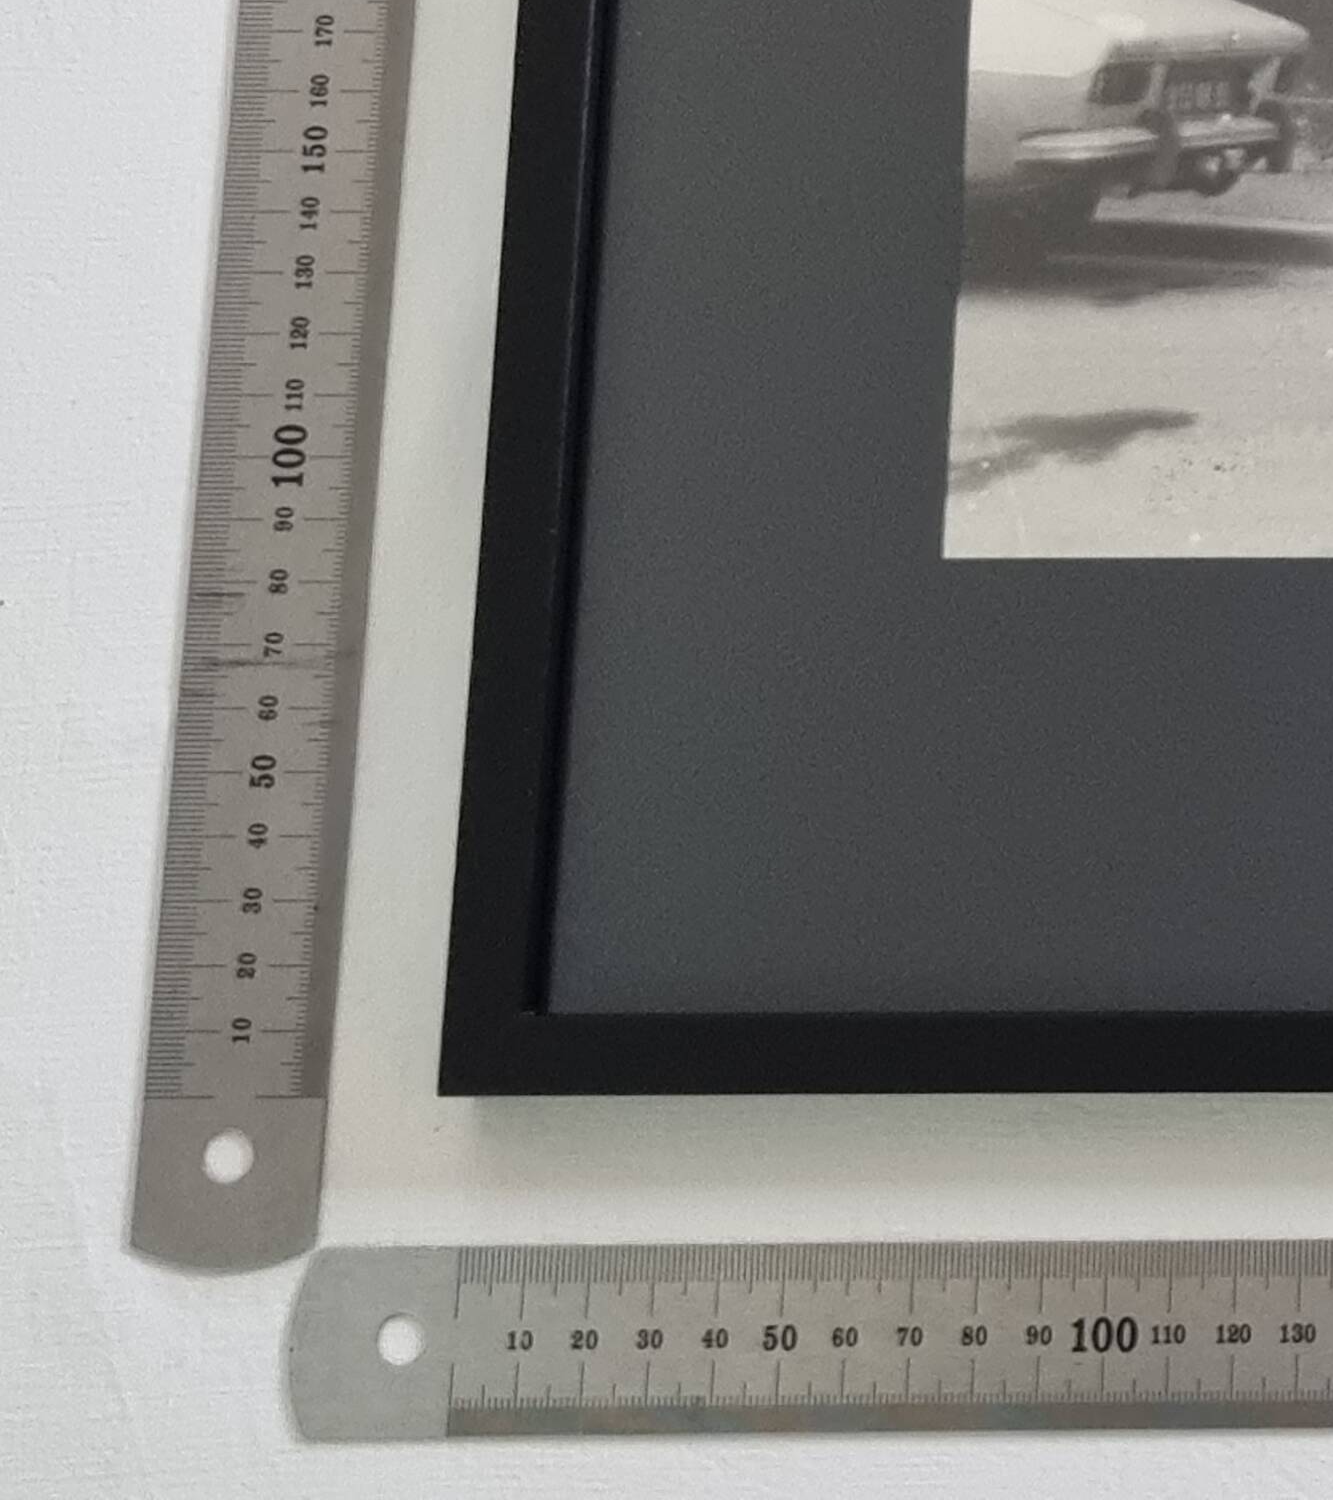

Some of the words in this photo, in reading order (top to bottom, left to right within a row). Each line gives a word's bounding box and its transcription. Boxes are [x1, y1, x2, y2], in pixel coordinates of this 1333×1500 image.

[314, 14, 334, 47] 170
[309, 74, 330, 107] 160
[300, 125, 328, 173] 150
[299, 196, 320, 230] 140
[294, 255, 315, 289] 130
[289, 316, 310, 350] 120
[284, 378, 305, 411] 110
[270, 424, 308, 488] 100
[273, 506, 294, 532] 90
[267, 569, 289, 595] 80
[264, 632, 284, 657] 70
[257, 695, 278, 722] 60
[249, 754, 277, 789] 50
[247, 823, 268, 849] 40
[240, 887, 263, 914] 30
[236, 952, 257, 979] 20
[231, 1017, 252, 1043] 10
[506, 1330, 533, 1351] 10
[570, 1329, 599, 1351] 20
[635, 1328, 664, 1350] 30
[700, 1328, 729, 1349] 40
[761, 1324, 798, 1352] 50
[830, 1326, 858, 1348] 60
[894, 1326, 923, 1347] 70
[960, 1325, 988, 1347] 80
[1025, 1325, 1052, 1346] 90
[1071, 1316, 1139, 1354] 100
[1151, 1324, 1186, 1345] 110
[1216, 1323, 1252, 1345] 120
[1279, 1323, 1317, 1344] 130
